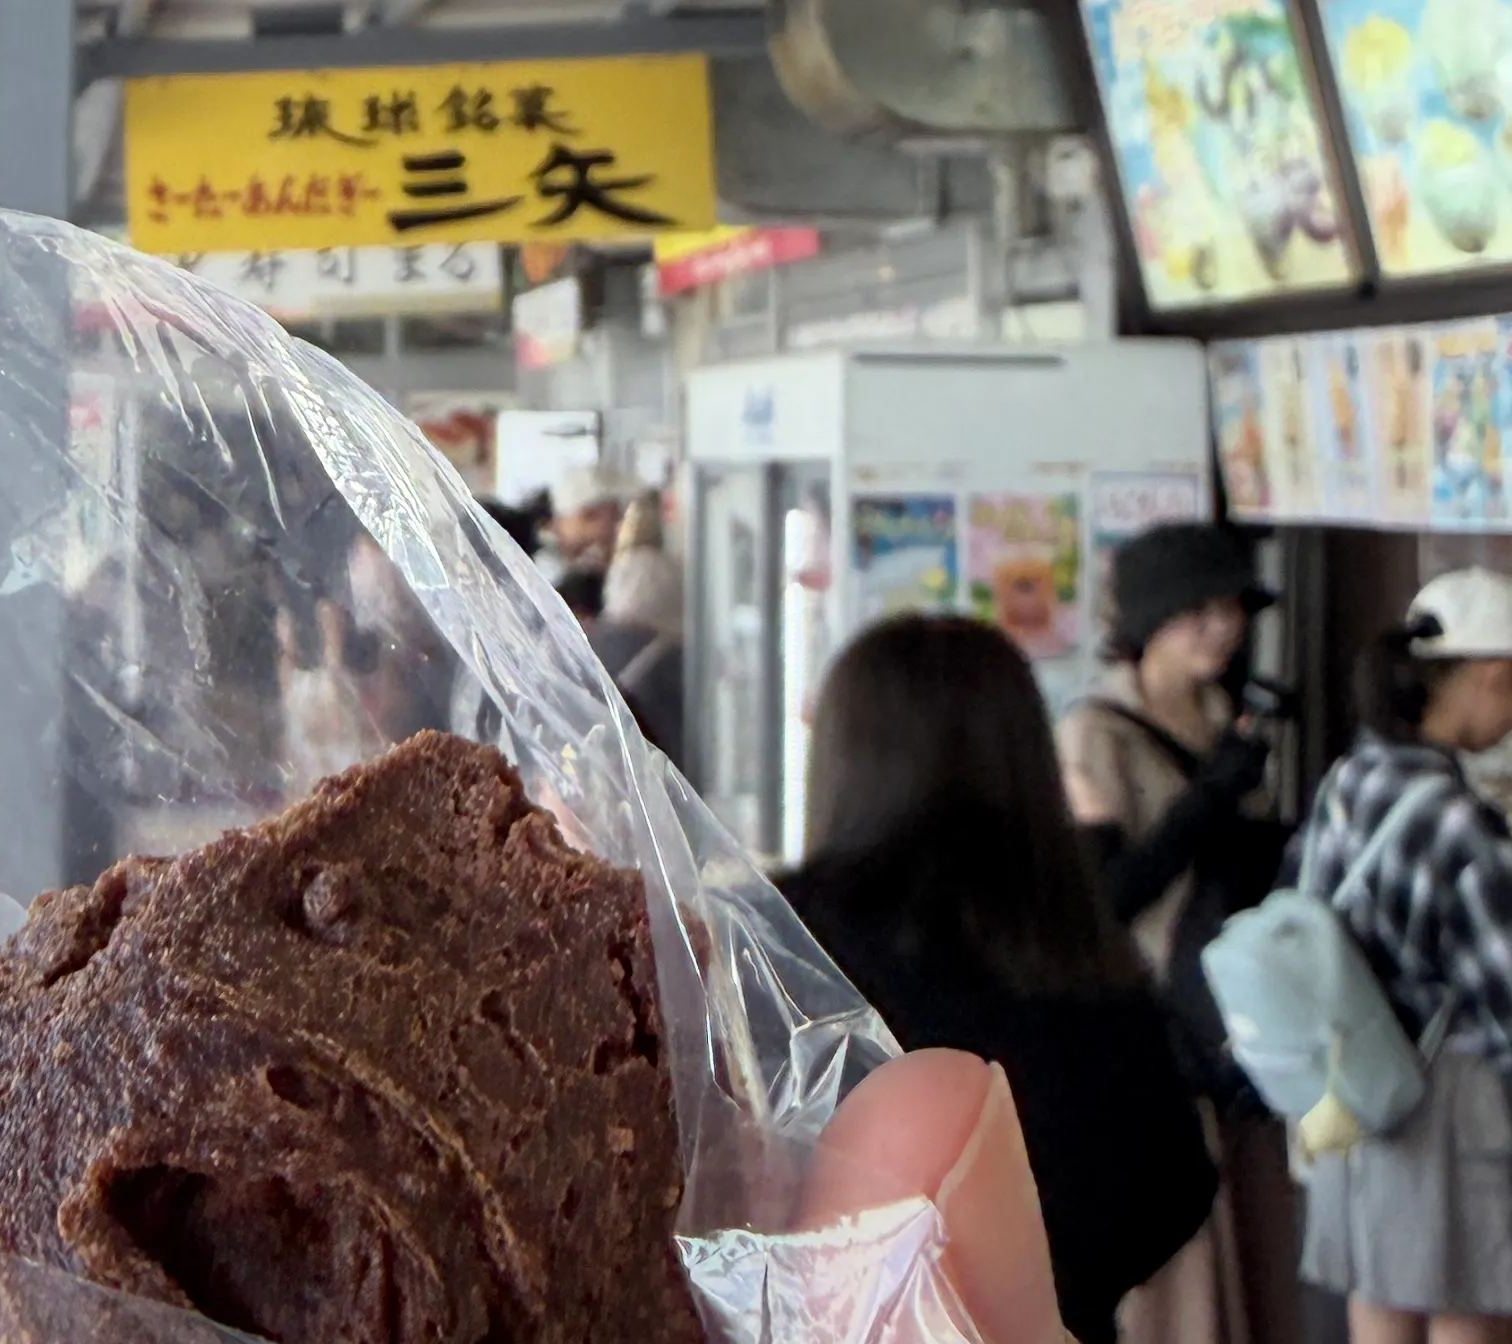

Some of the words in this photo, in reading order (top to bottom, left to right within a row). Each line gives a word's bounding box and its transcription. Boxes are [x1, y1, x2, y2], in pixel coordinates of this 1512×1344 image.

[267, 80, 584, 147] 琉球銘菓
[387, 140, 683, 232] 三矢
